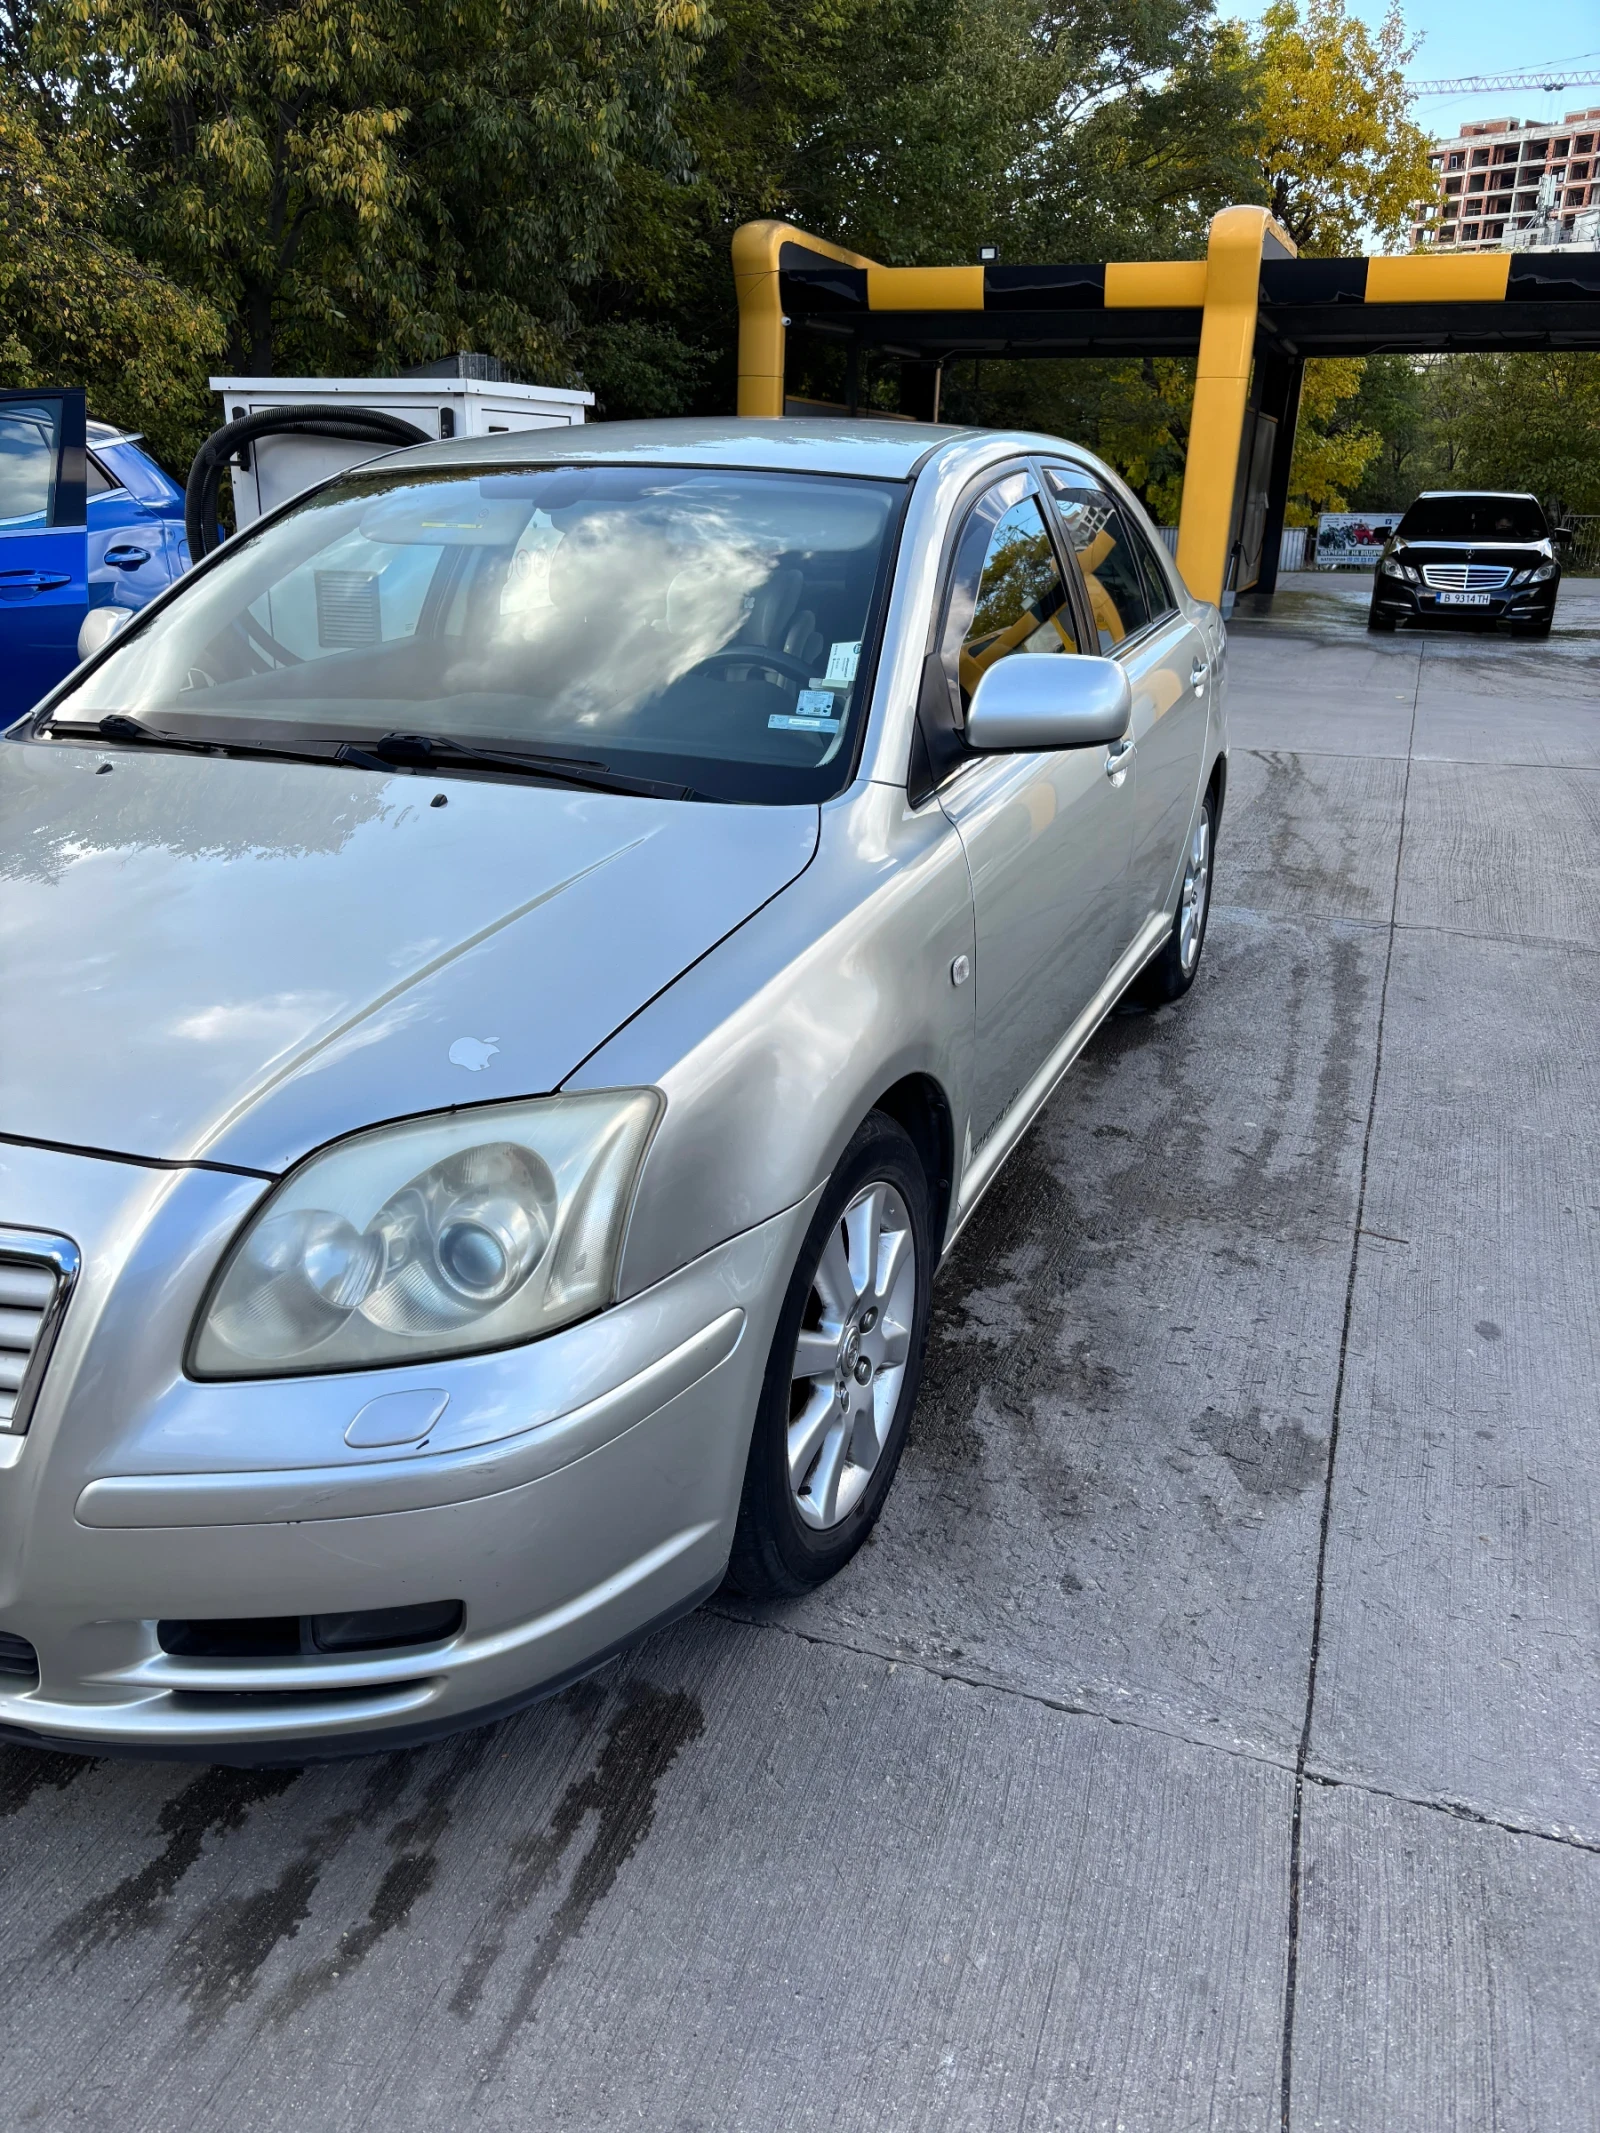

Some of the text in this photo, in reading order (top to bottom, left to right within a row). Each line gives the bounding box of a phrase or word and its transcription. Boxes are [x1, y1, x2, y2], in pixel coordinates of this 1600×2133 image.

[1444, 593, 1489, 604] B 9314 TH
